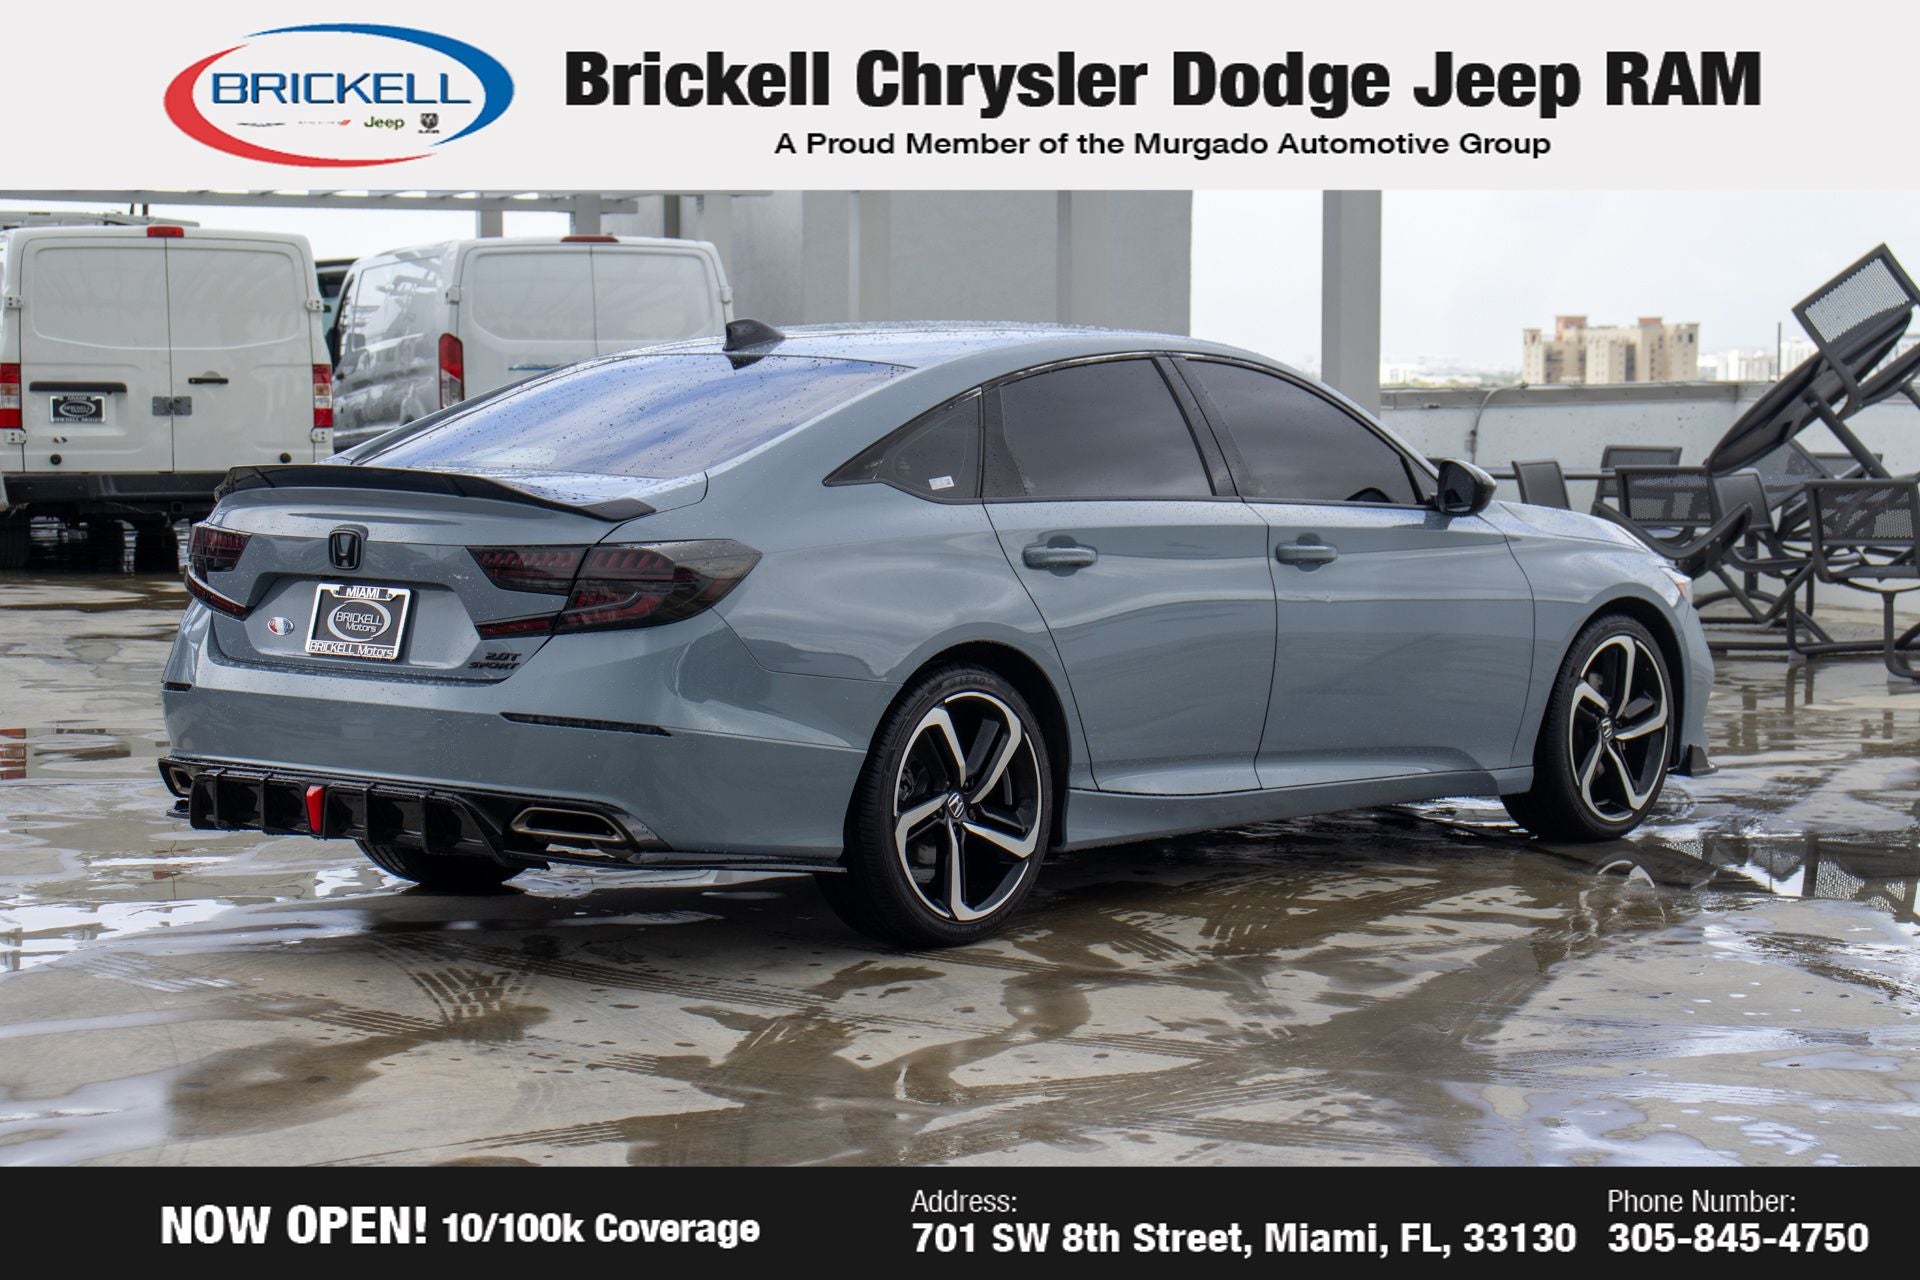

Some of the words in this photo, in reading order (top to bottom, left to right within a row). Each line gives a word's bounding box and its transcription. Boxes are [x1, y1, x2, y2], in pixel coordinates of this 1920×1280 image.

[346, 587, 380, 598] MIAMI
[335, 611, 383, 626] BRICKELL
[345, 621, 377, 633] Motors
[309, 640, 355, 655] BRICKELL
[357, 645, 395, 658] Motors
